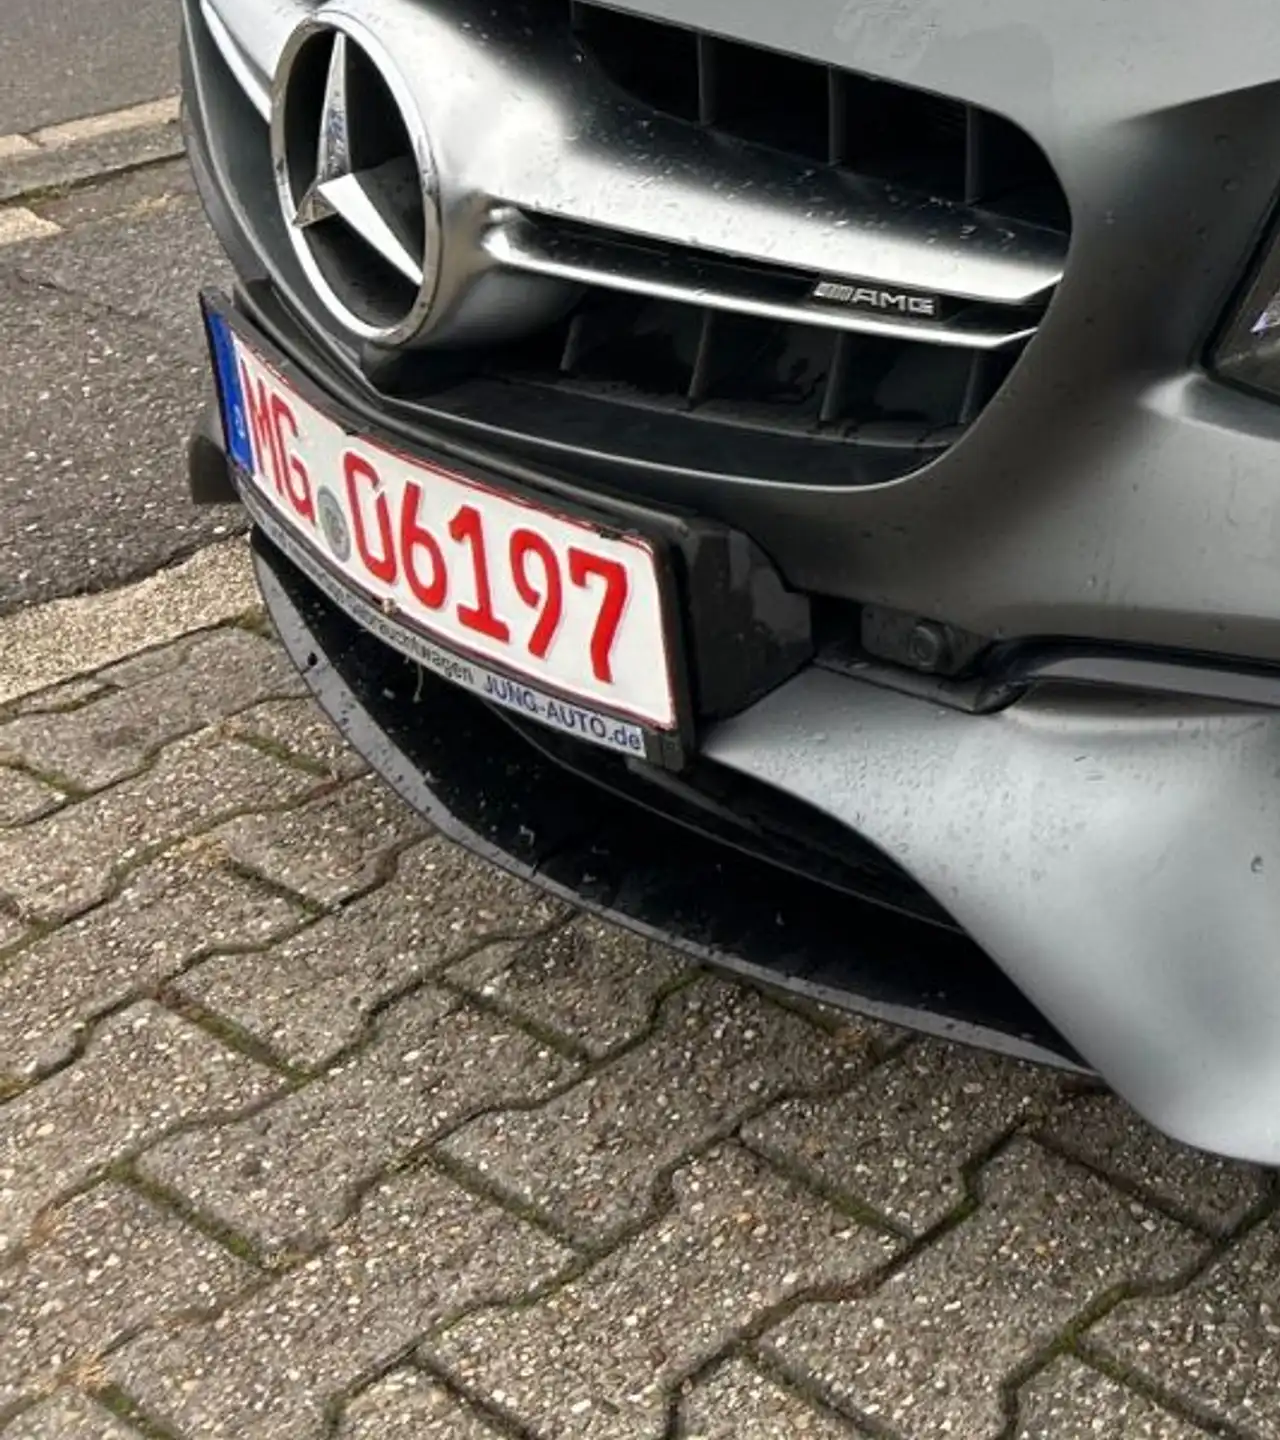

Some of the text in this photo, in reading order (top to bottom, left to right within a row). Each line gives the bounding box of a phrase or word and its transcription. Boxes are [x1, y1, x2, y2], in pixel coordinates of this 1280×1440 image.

[850, 287, 936, 316] AMG
[240, 356, 317, 526] MG
[343, 450, 629, 685] 06197
[482, 673, 642, 750] JUNG-AUTO.de
